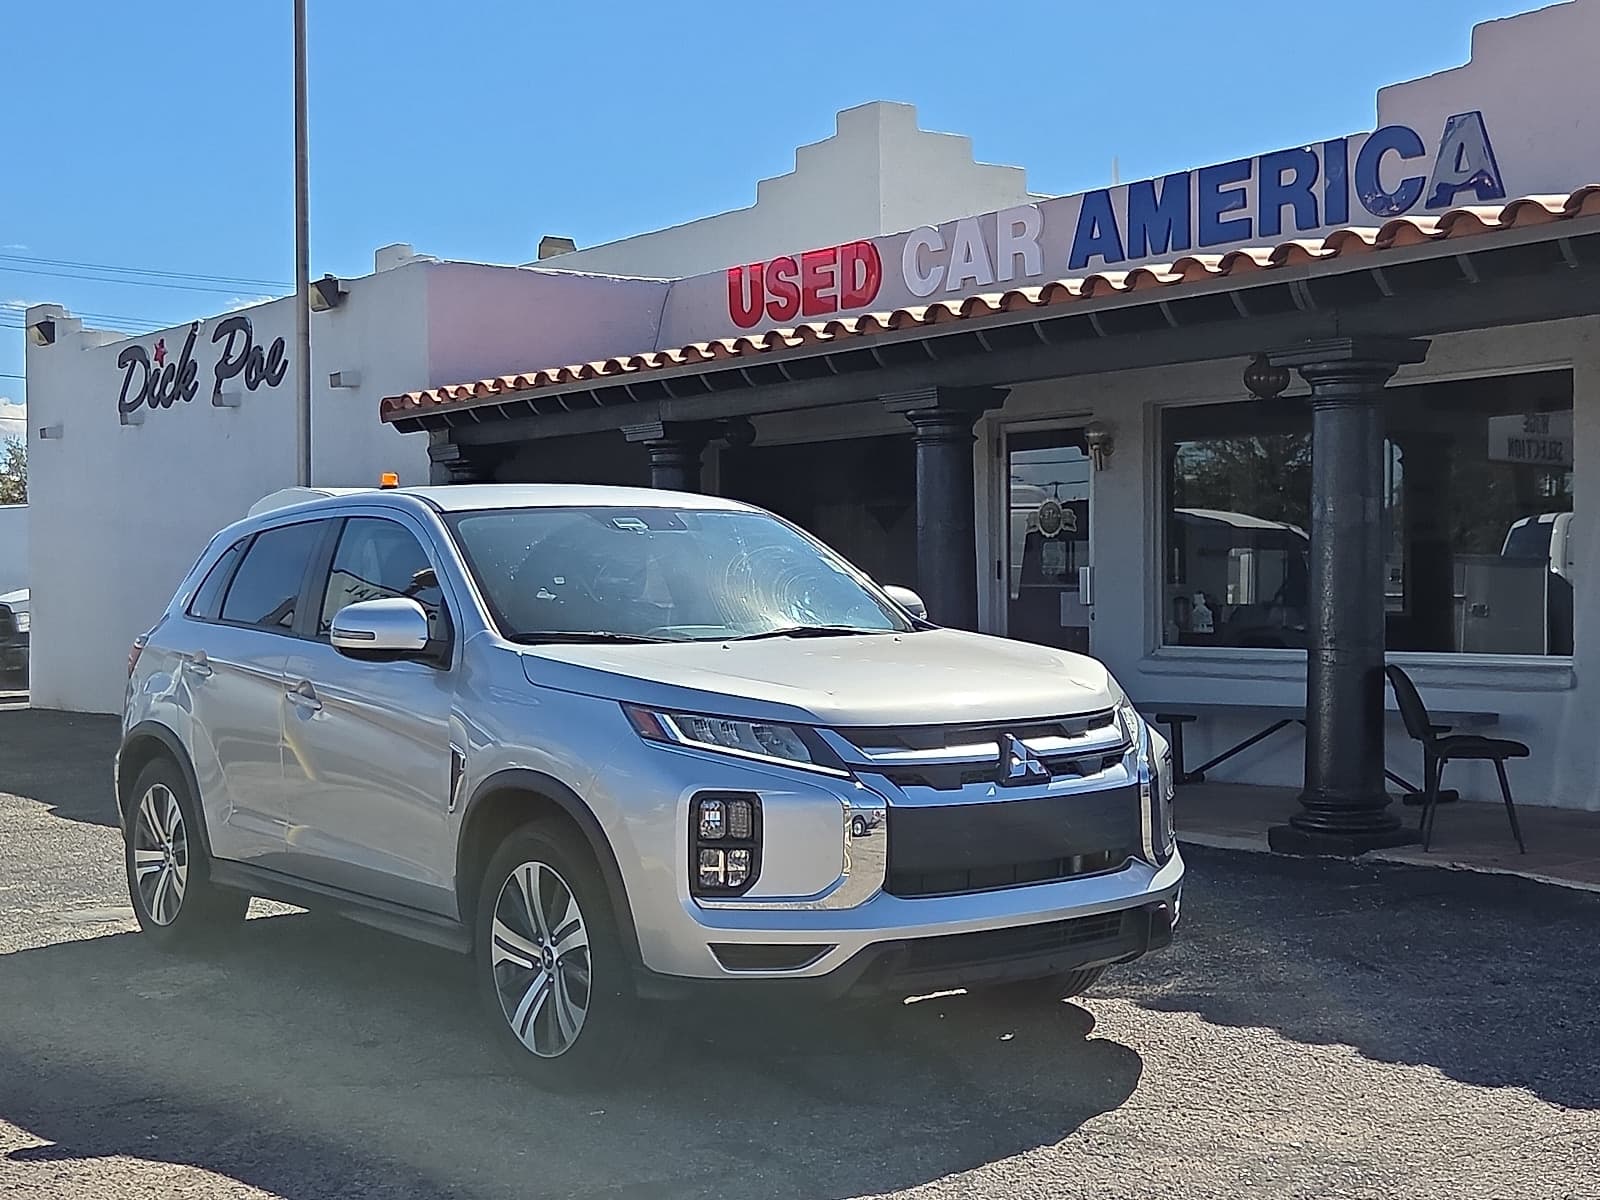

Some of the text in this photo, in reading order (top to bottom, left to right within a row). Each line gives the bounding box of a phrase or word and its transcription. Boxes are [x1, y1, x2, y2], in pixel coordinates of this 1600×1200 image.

[728, 111, 1506, 328] USED CAR AMERICA
[118, 316, 288, 414] Dick Poe
